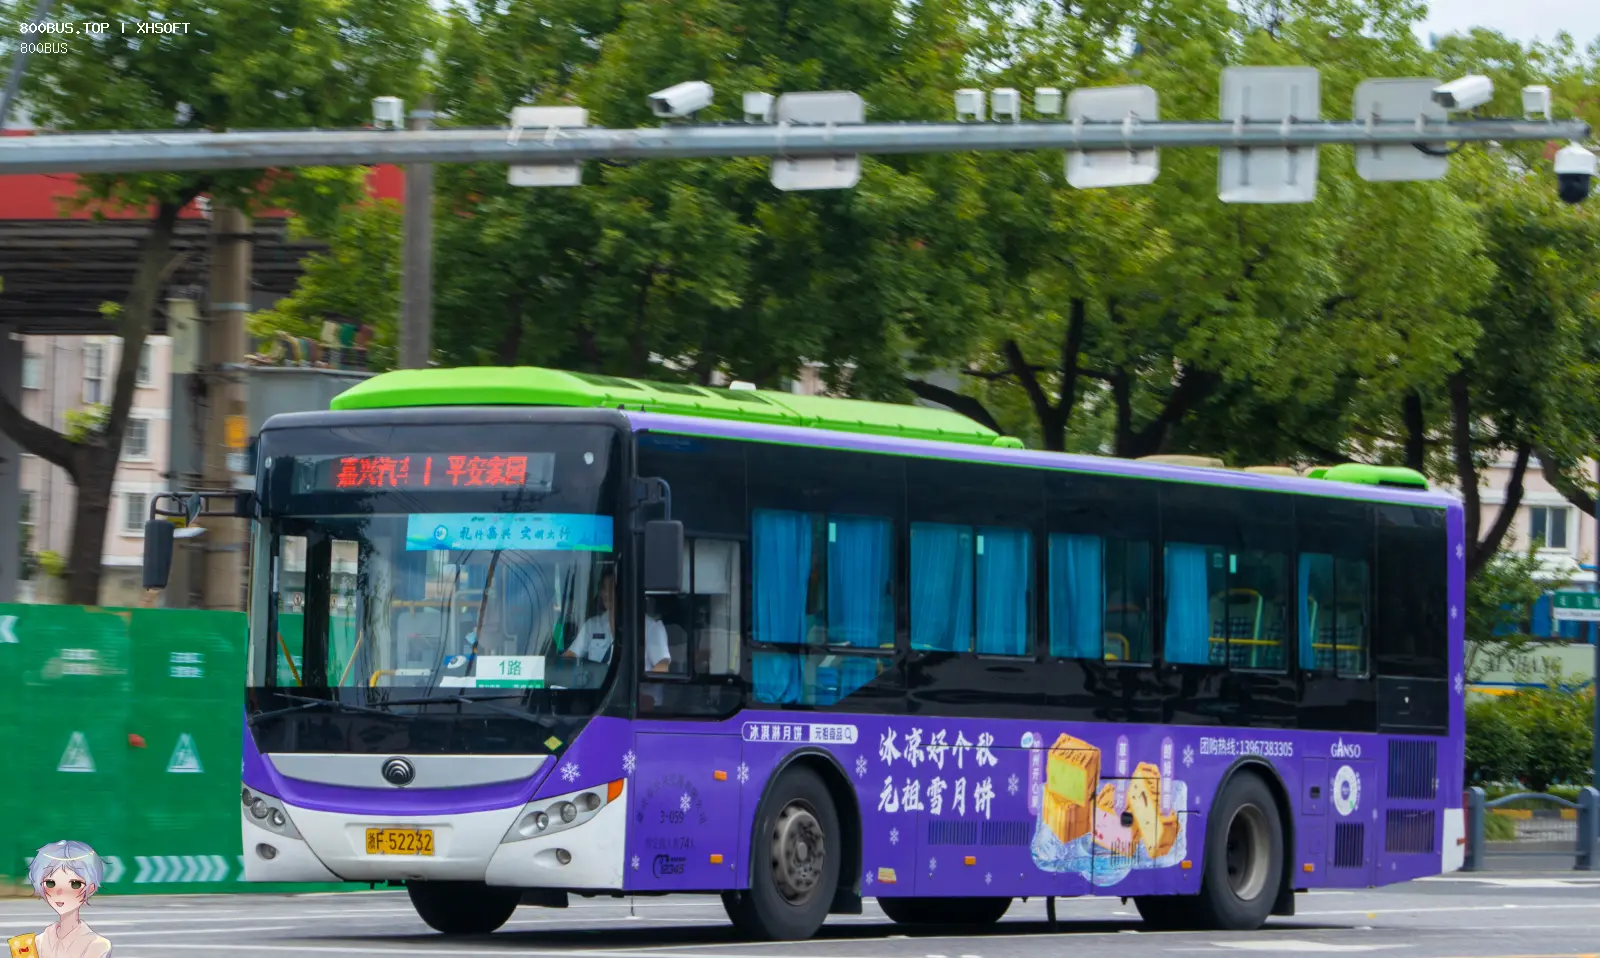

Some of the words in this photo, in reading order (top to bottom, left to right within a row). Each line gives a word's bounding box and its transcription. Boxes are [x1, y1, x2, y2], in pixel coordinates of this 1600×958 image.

[499, 660, 522, 676] 1路
[749, 724, 803, 741] 冰淇淋月饼
[878, 727, 998, 769] 冰凉好个秋
[1331, 736, 1361, 758] GANSO
[877, 775, 996, 820] 元祖雪月饼
[660, 811, 684, 824] 3-059
